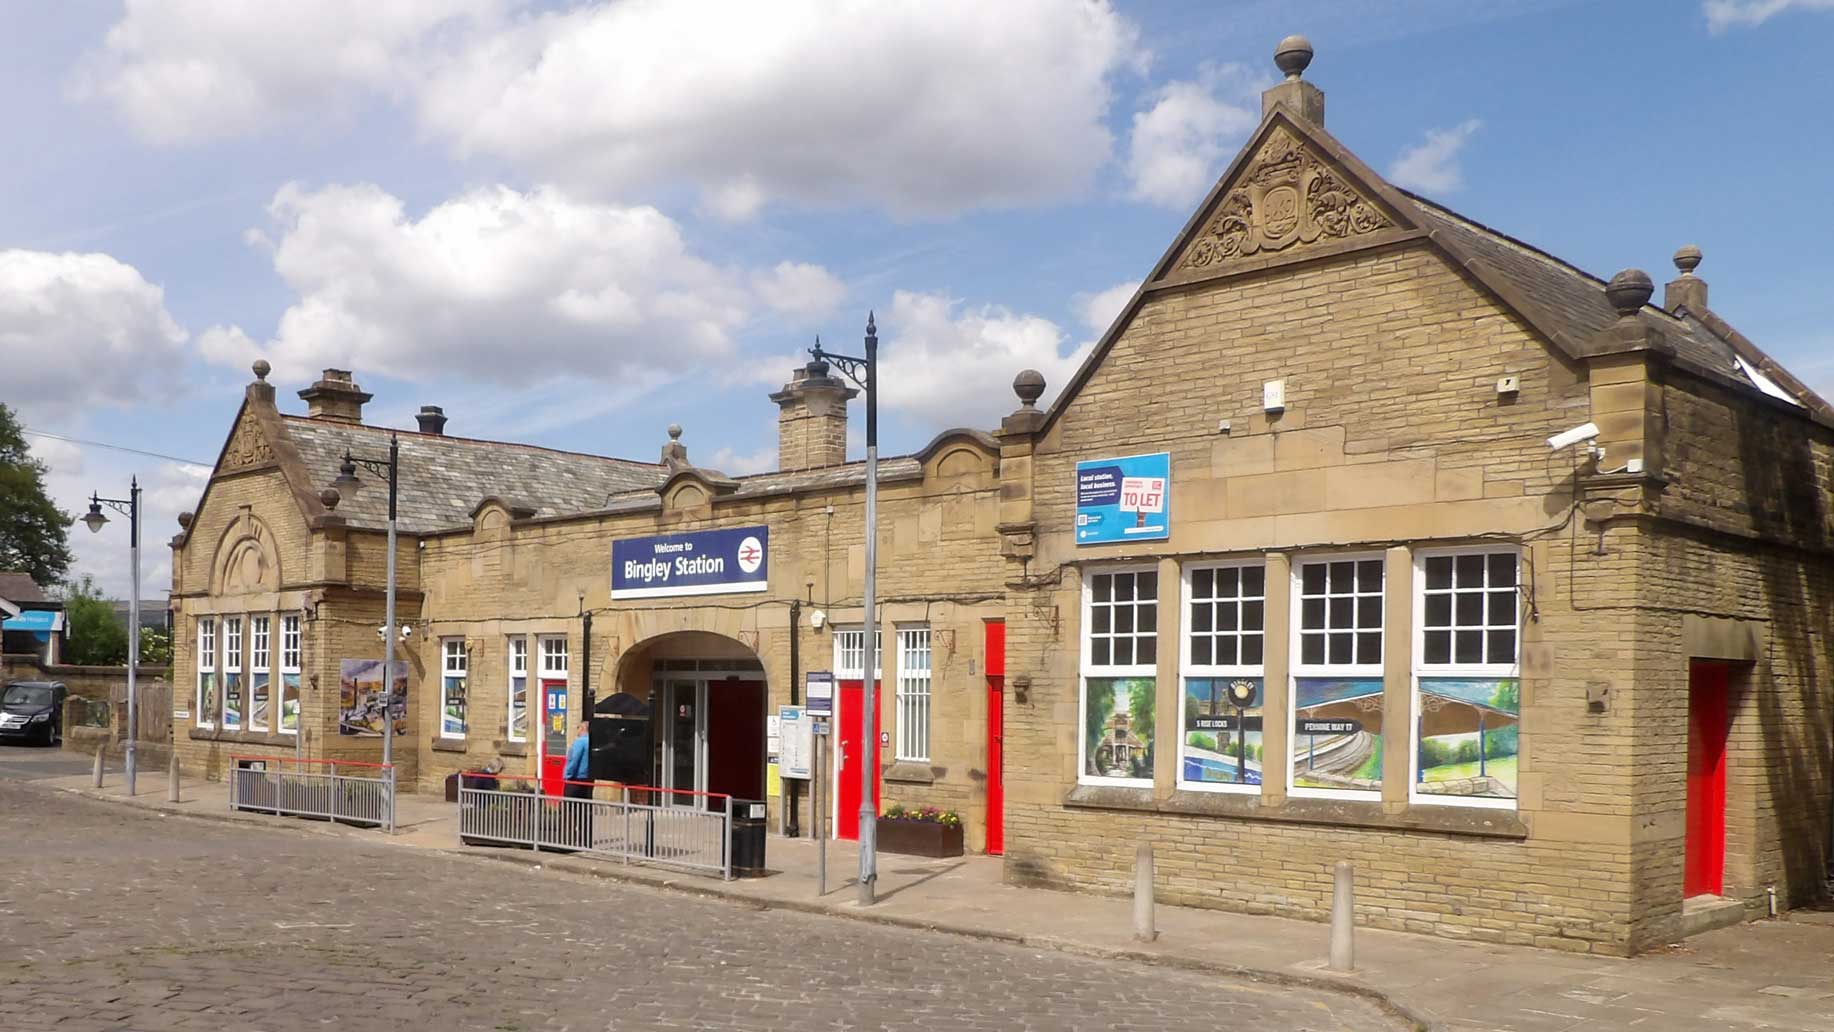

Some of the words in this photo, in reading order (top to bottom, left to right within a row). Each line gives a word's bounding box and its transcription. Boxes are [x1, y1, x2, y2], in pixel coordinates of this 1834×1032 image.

[1125, 493, 1137, 506] TO
[1140, 492, 1161, 507] LET
[654, 543, 684, 554] Welcome
[685, 542, 693, 551] to
[625, 558, 671, 583] Bingley
[675, 555, 724, 576] Station
[1212, 720, 1227, 728] LOCKS
[1331, 723, 1345, 731] WAY
